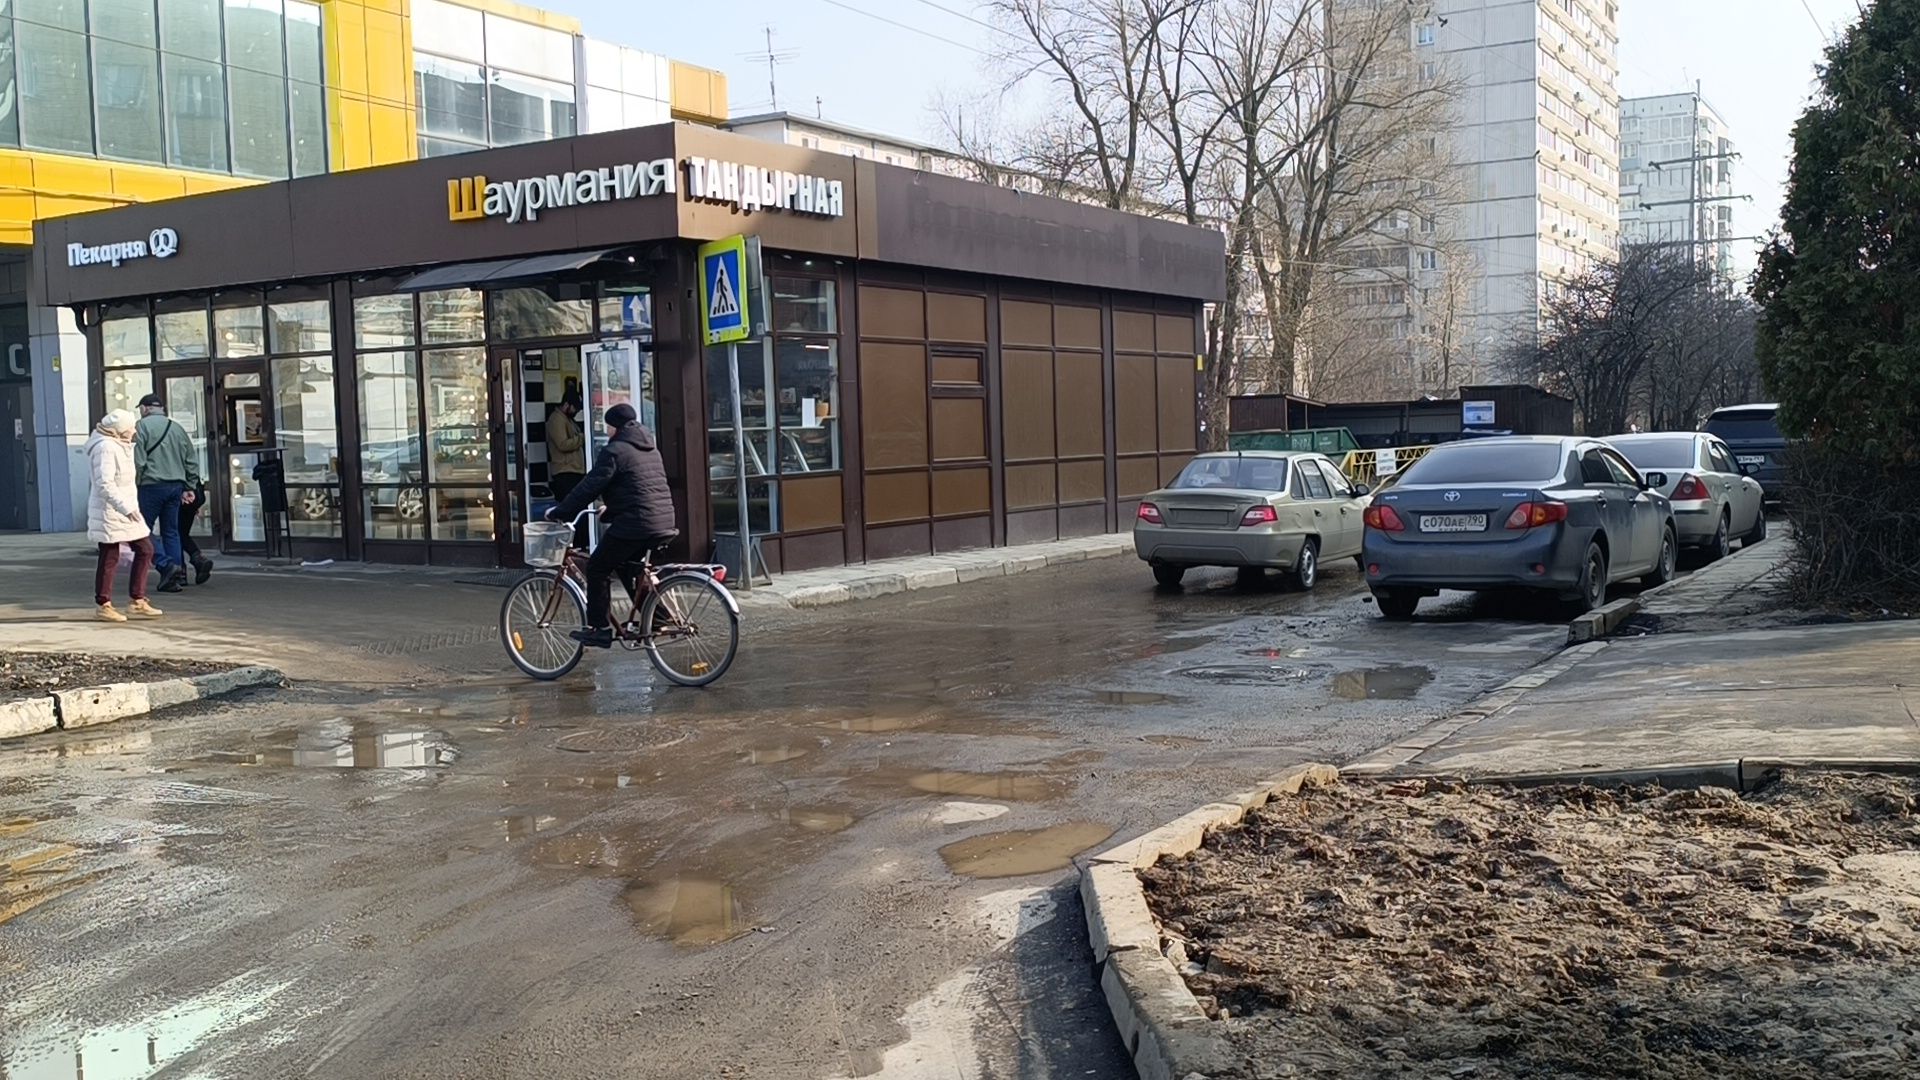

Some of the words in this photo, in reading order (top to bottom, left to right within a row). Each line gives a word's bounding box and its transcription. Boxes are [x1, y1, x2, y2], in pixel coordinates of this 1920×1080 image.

[447, 158, 676, 223] Шаурмания
[688, 155, 844, 217] ТАНДЫРНАЯ
[67, 239, 148, 267] Пекарня
